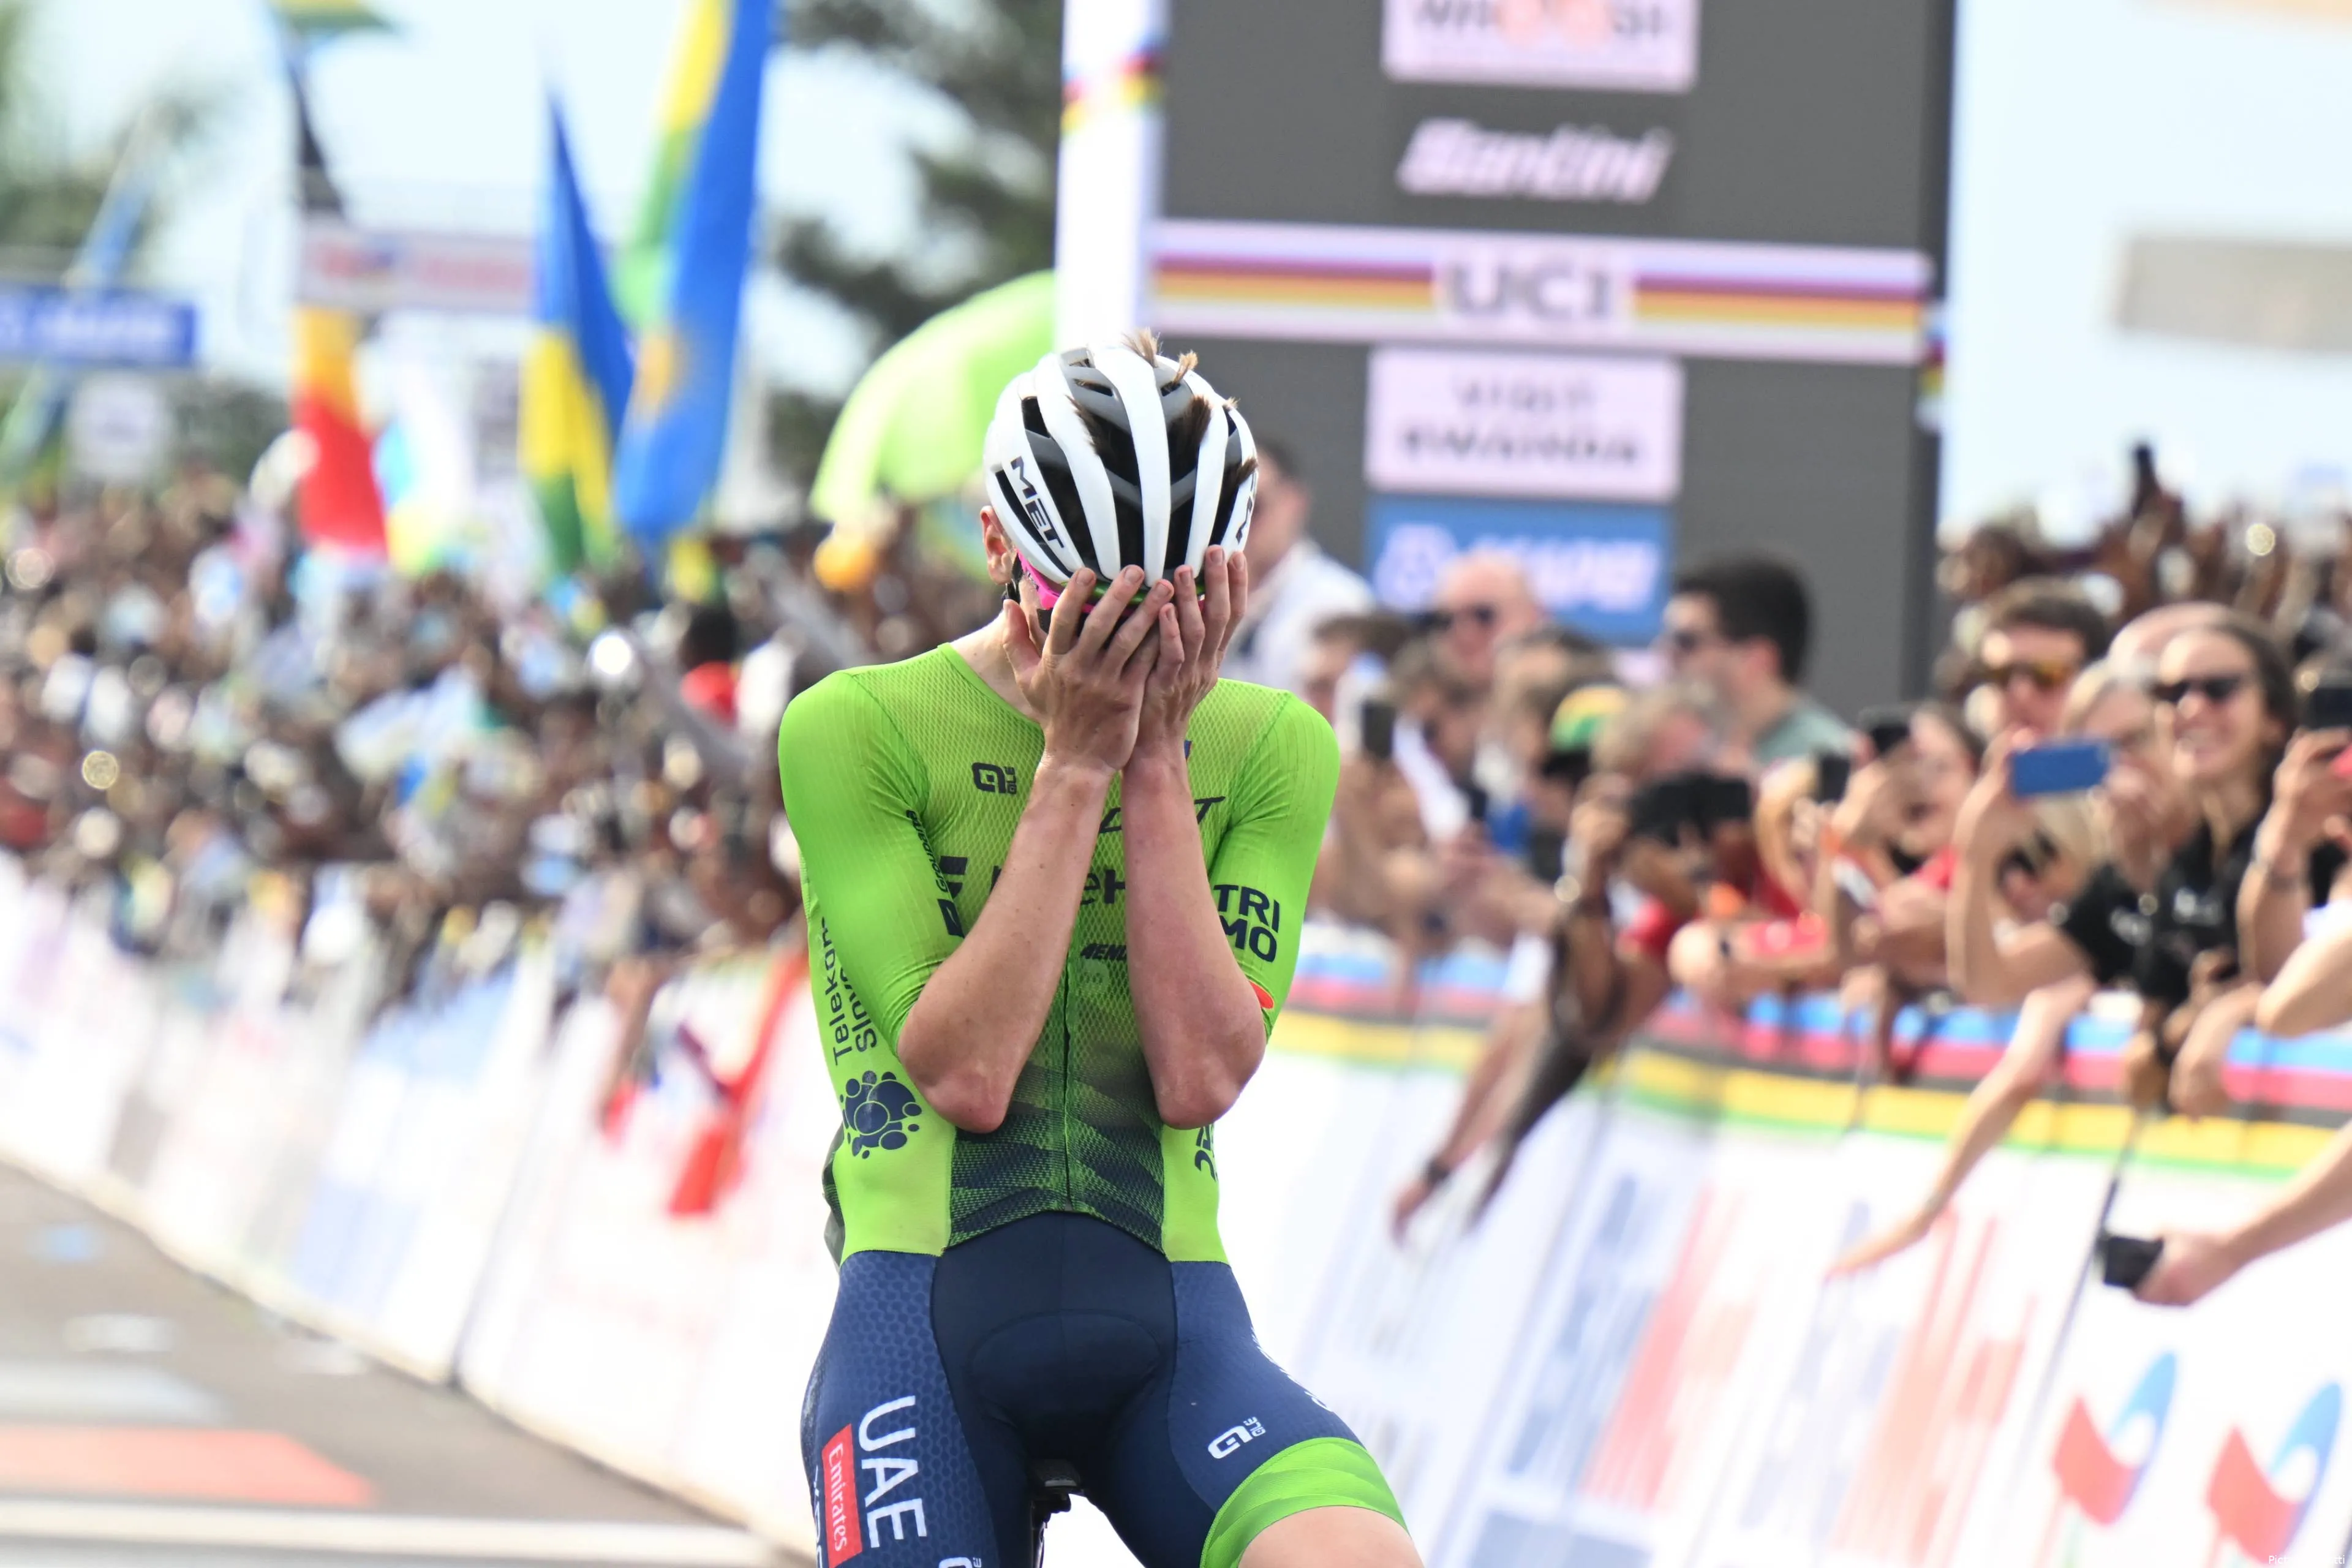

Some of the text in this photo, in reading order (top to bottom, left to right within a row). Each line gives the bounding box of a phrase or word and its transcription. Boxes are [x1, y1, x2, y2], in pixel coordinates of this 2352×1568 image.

[1449, 263, 1610, 320] UCI
[1011, 456, 1065, 549] MET
[1213, 884, 1280, 933] TRI
[1218, 915, 1277, 962] MO
[828, 1442, 848, 1551] Emirates
[859, 1395, 927, 1548] UAE
